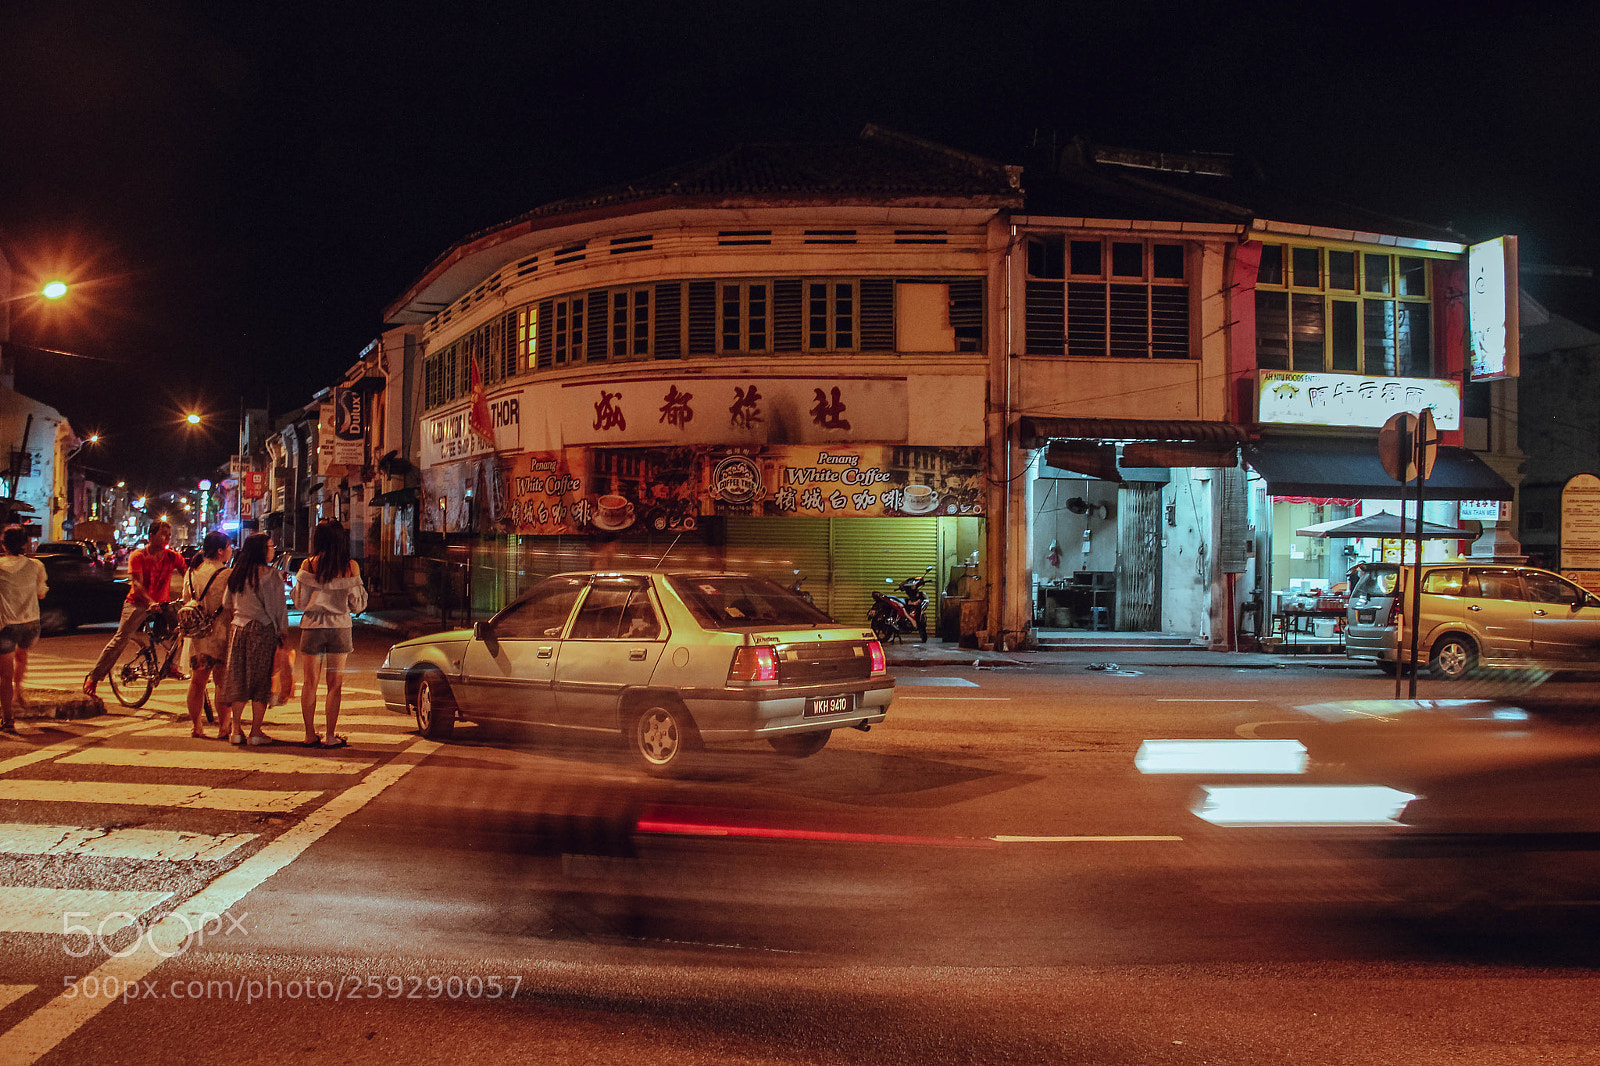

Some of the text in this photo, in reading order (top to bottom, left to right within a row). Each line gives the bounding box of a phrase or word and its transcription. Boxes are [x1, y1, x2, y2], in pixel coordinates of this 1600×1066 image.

[349, 396, 362, 435] Dulux
[490, 398, 519, 429] THOR
[530, 458, 558, 473] Penang
[818, 452, 859, 466] Penang
[786, 467, 891, 485] White Coffee
[515, 474, 581, 497] White Coffee
[813, 697, 847, 714] WKH 9410
